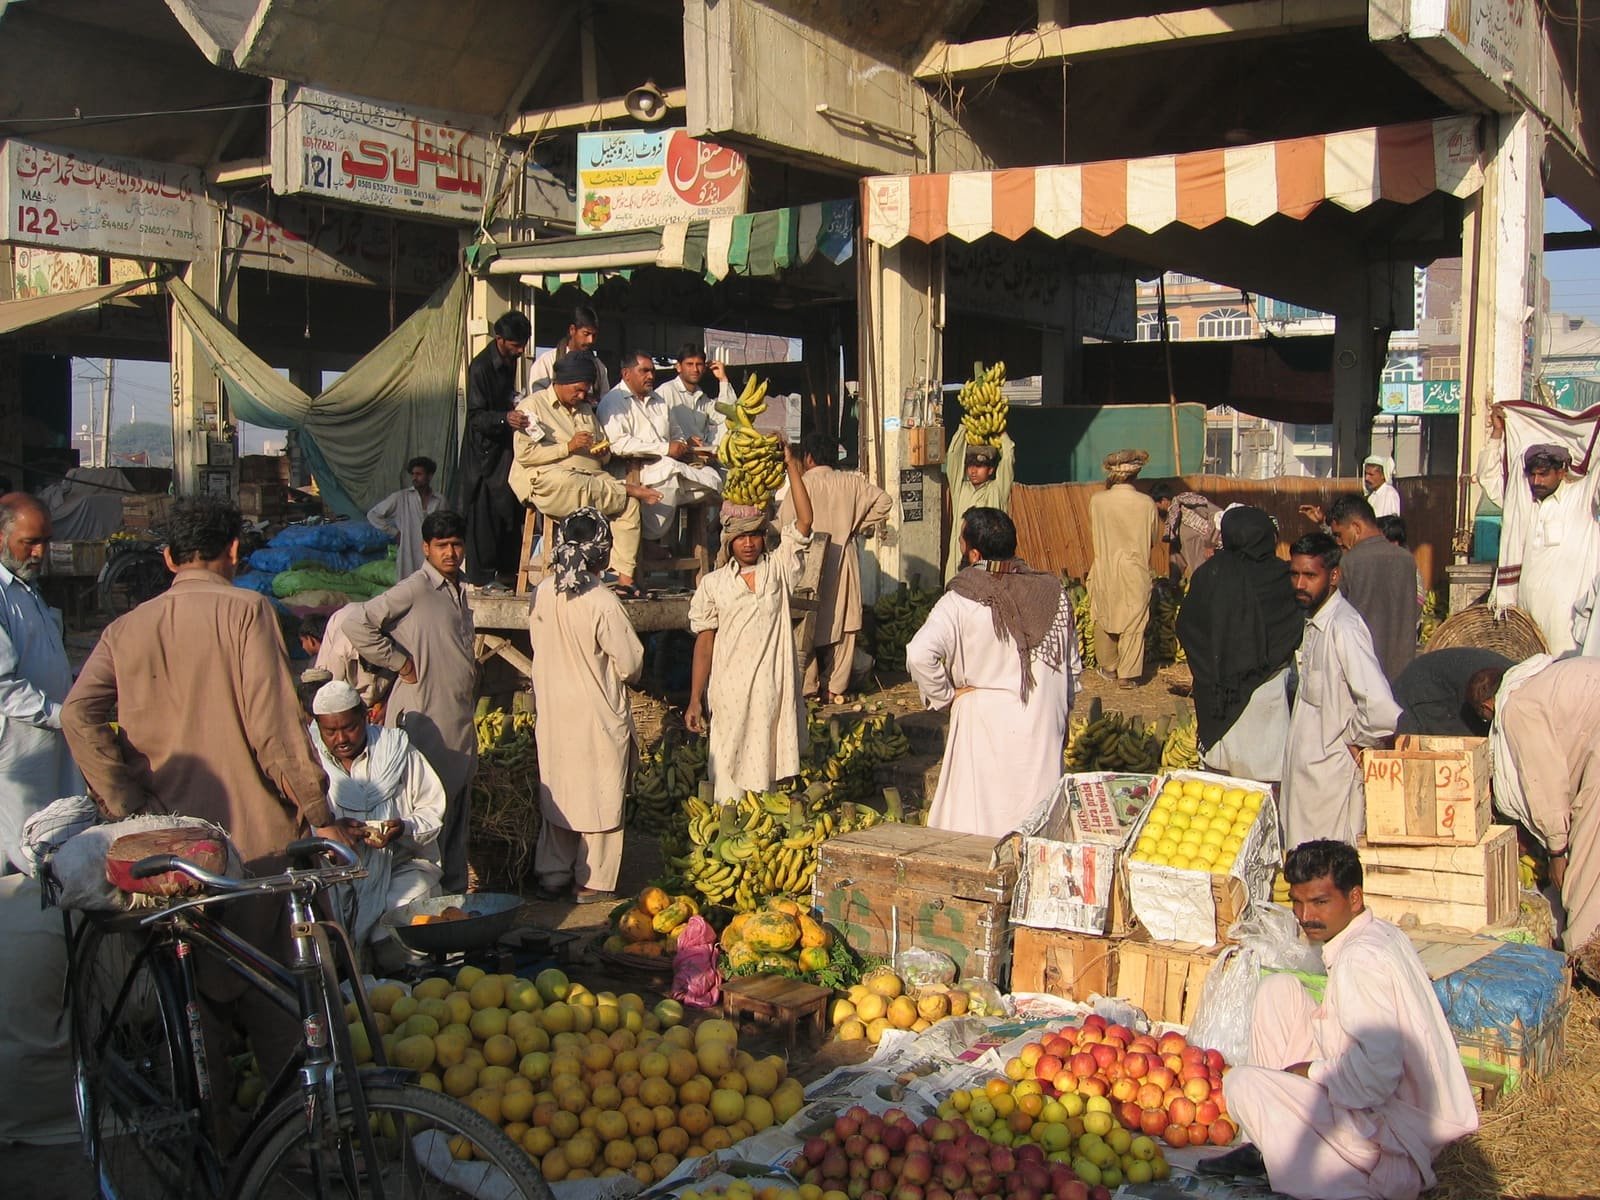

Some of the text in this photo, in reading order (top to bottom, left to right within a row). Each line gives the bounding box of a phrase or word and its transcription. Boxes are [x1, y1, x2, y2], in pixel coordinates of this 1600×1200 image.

[635, 136, 663, 159] فروٹ
[304, 153, 332, 189] 121
[627, 168, 662, 186] کمیشن
[18, 206, 60, 236] 122
[172, 351, 182, 409] 123
